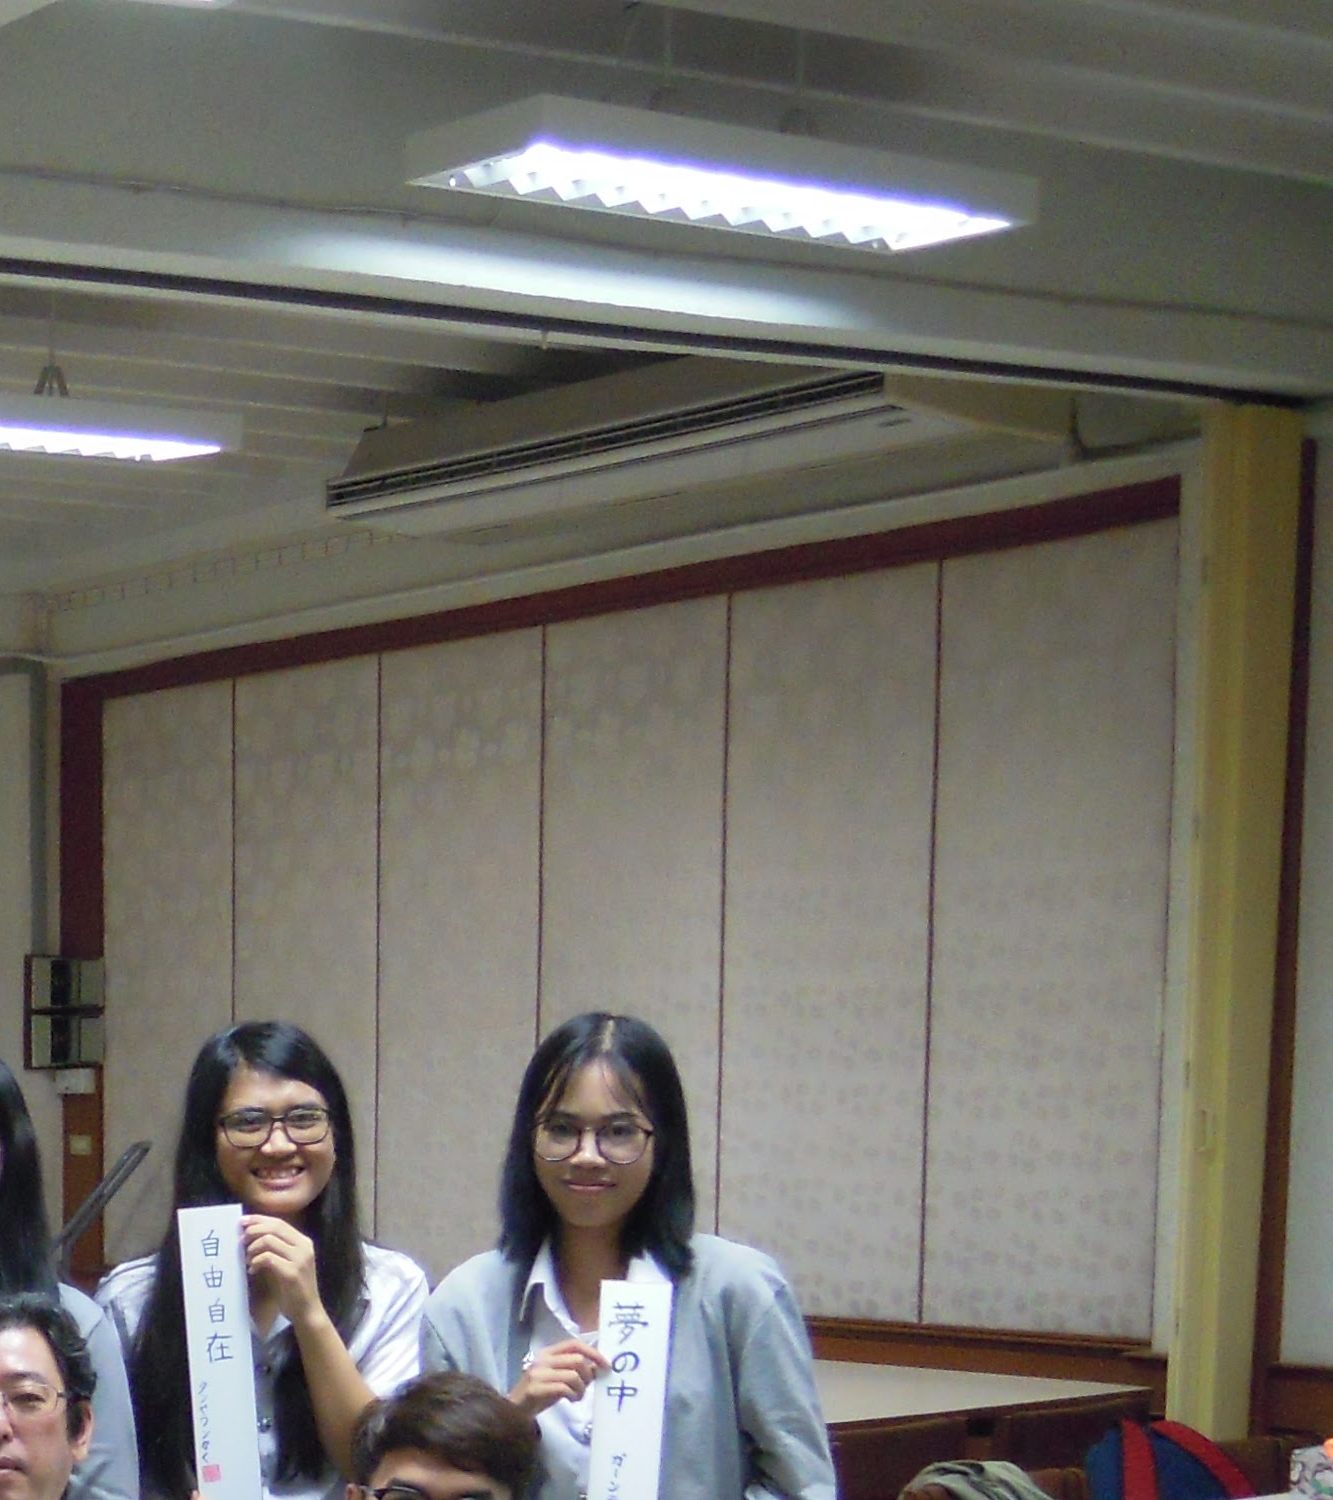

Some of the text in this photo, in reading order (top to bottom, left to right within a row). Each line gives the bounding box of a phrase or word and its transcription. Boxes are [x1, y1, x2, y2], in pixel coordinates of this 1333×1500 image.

[200, 1229, 234, 1364] 自由自在
[607, 1301, 649, 1413] 夢の中
